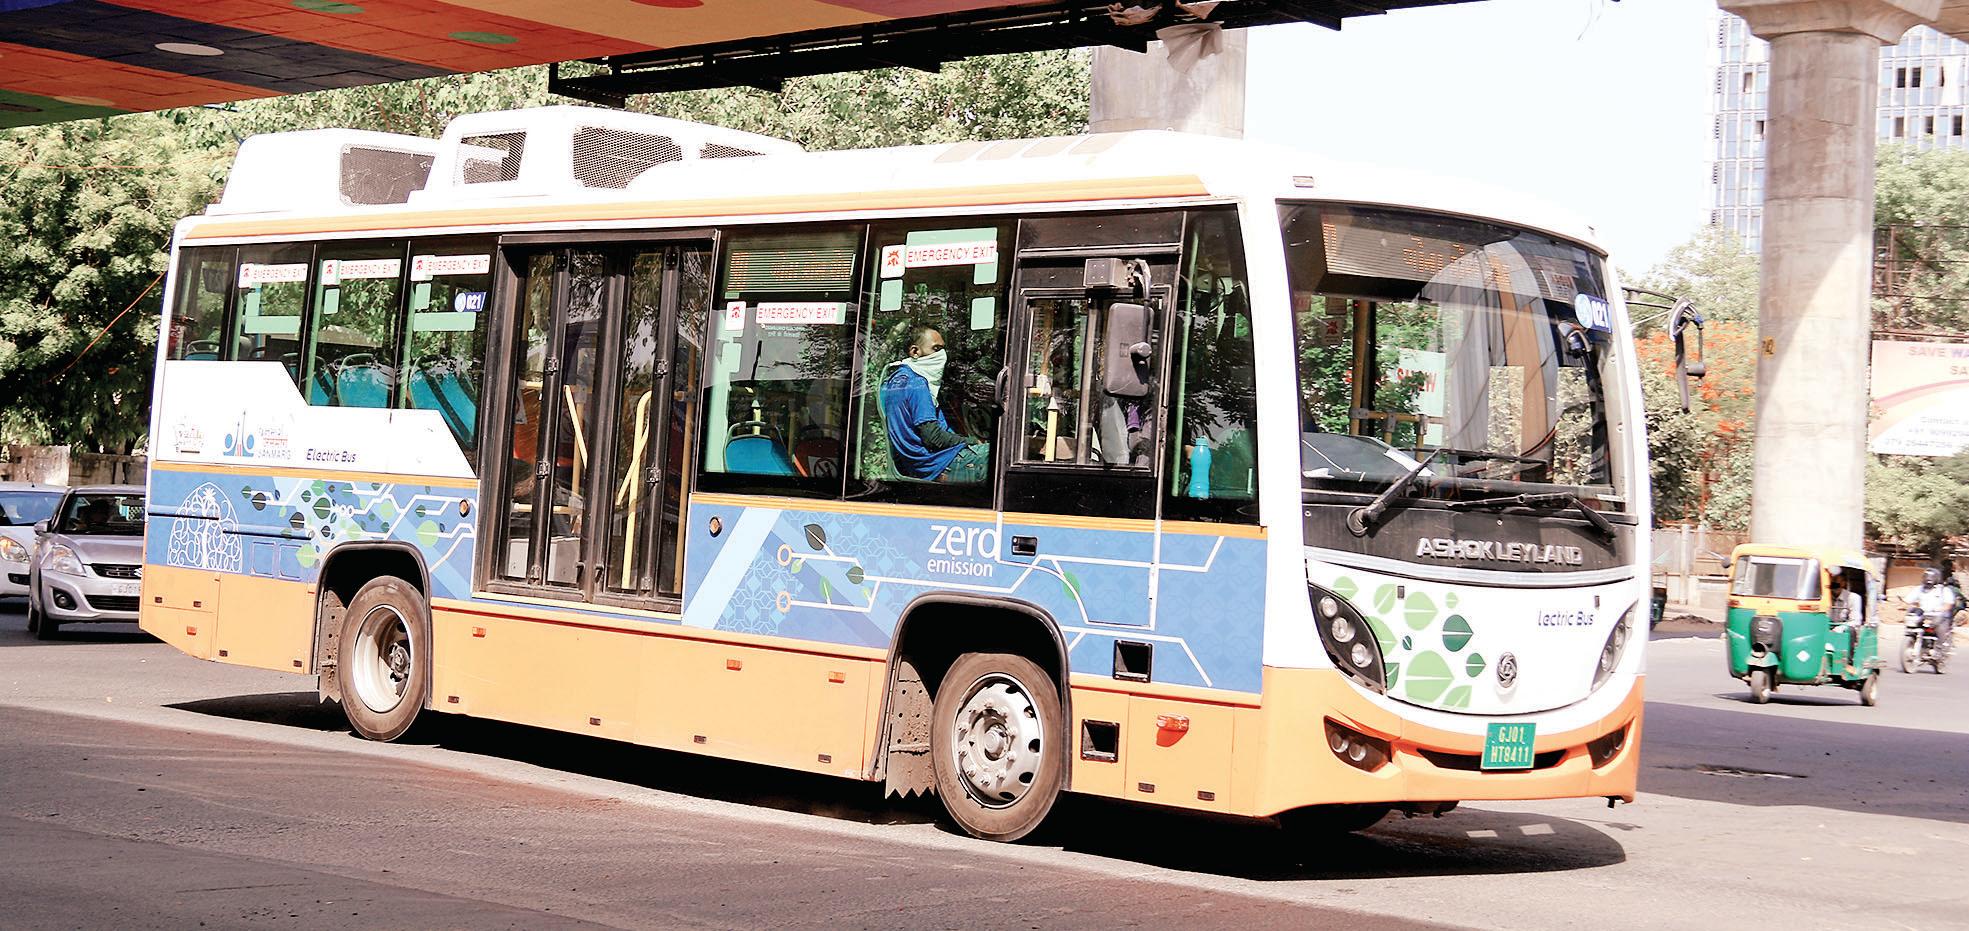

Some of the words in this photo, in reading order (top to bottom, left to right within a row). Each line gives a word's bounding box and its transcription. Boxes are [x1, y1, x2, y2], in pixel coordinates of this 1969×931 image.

[907, 248, 970, 263] EMERGENCY
[972, 245, 995, 259] EXIT
[254, 268, 291, 279] EMERGENCY
[293, 267, 306, 278] EXIT
[340, 264, 380, 275] EMERGENCY
[383, 263, 398, 274] EXIT
[428, 260, 470, 271] EMERGENCY
[473, 259, 488, 270] EXIT
[466, 294, 482, 310] 021
[758, 307, 814, 319] EMERGENCY
[816, 307, 837, 319] EXIT
[1591, 300, 1609, 328] 021
[1908, 345, 1946, 357] SAVE
[306, 448, 340, 463] Electric
[341, 450, 357, 463] Bus
[928, 525, 998, 559] zero
[1416, 537, 1495, 561] ASHOK
[1495, 541, 1583, 565] LEYLAND
[927, 557, 993, 577] emission
[1576, 611, 1594, 626] Bus
[1498, 726, 1525, 743] GJ01
[1490, 745, 1529, 763] HT8411
